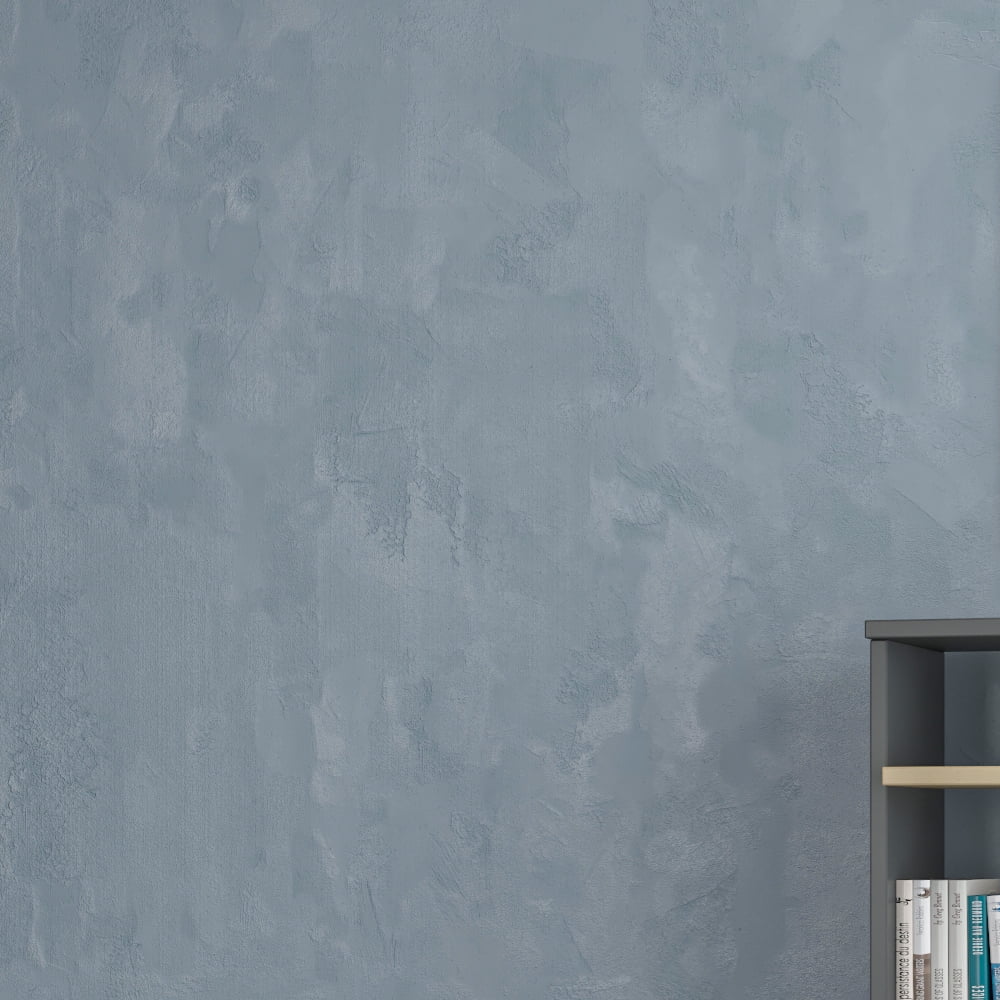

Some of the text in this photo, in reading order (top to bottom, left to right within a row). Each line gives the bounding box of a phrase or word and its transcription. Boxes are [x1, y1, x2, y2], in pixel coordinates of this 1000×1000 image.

[896, 922, 910, 944] destin
[896, 946, 910, 956] du
[896, 958, 912, 1000] persistance
